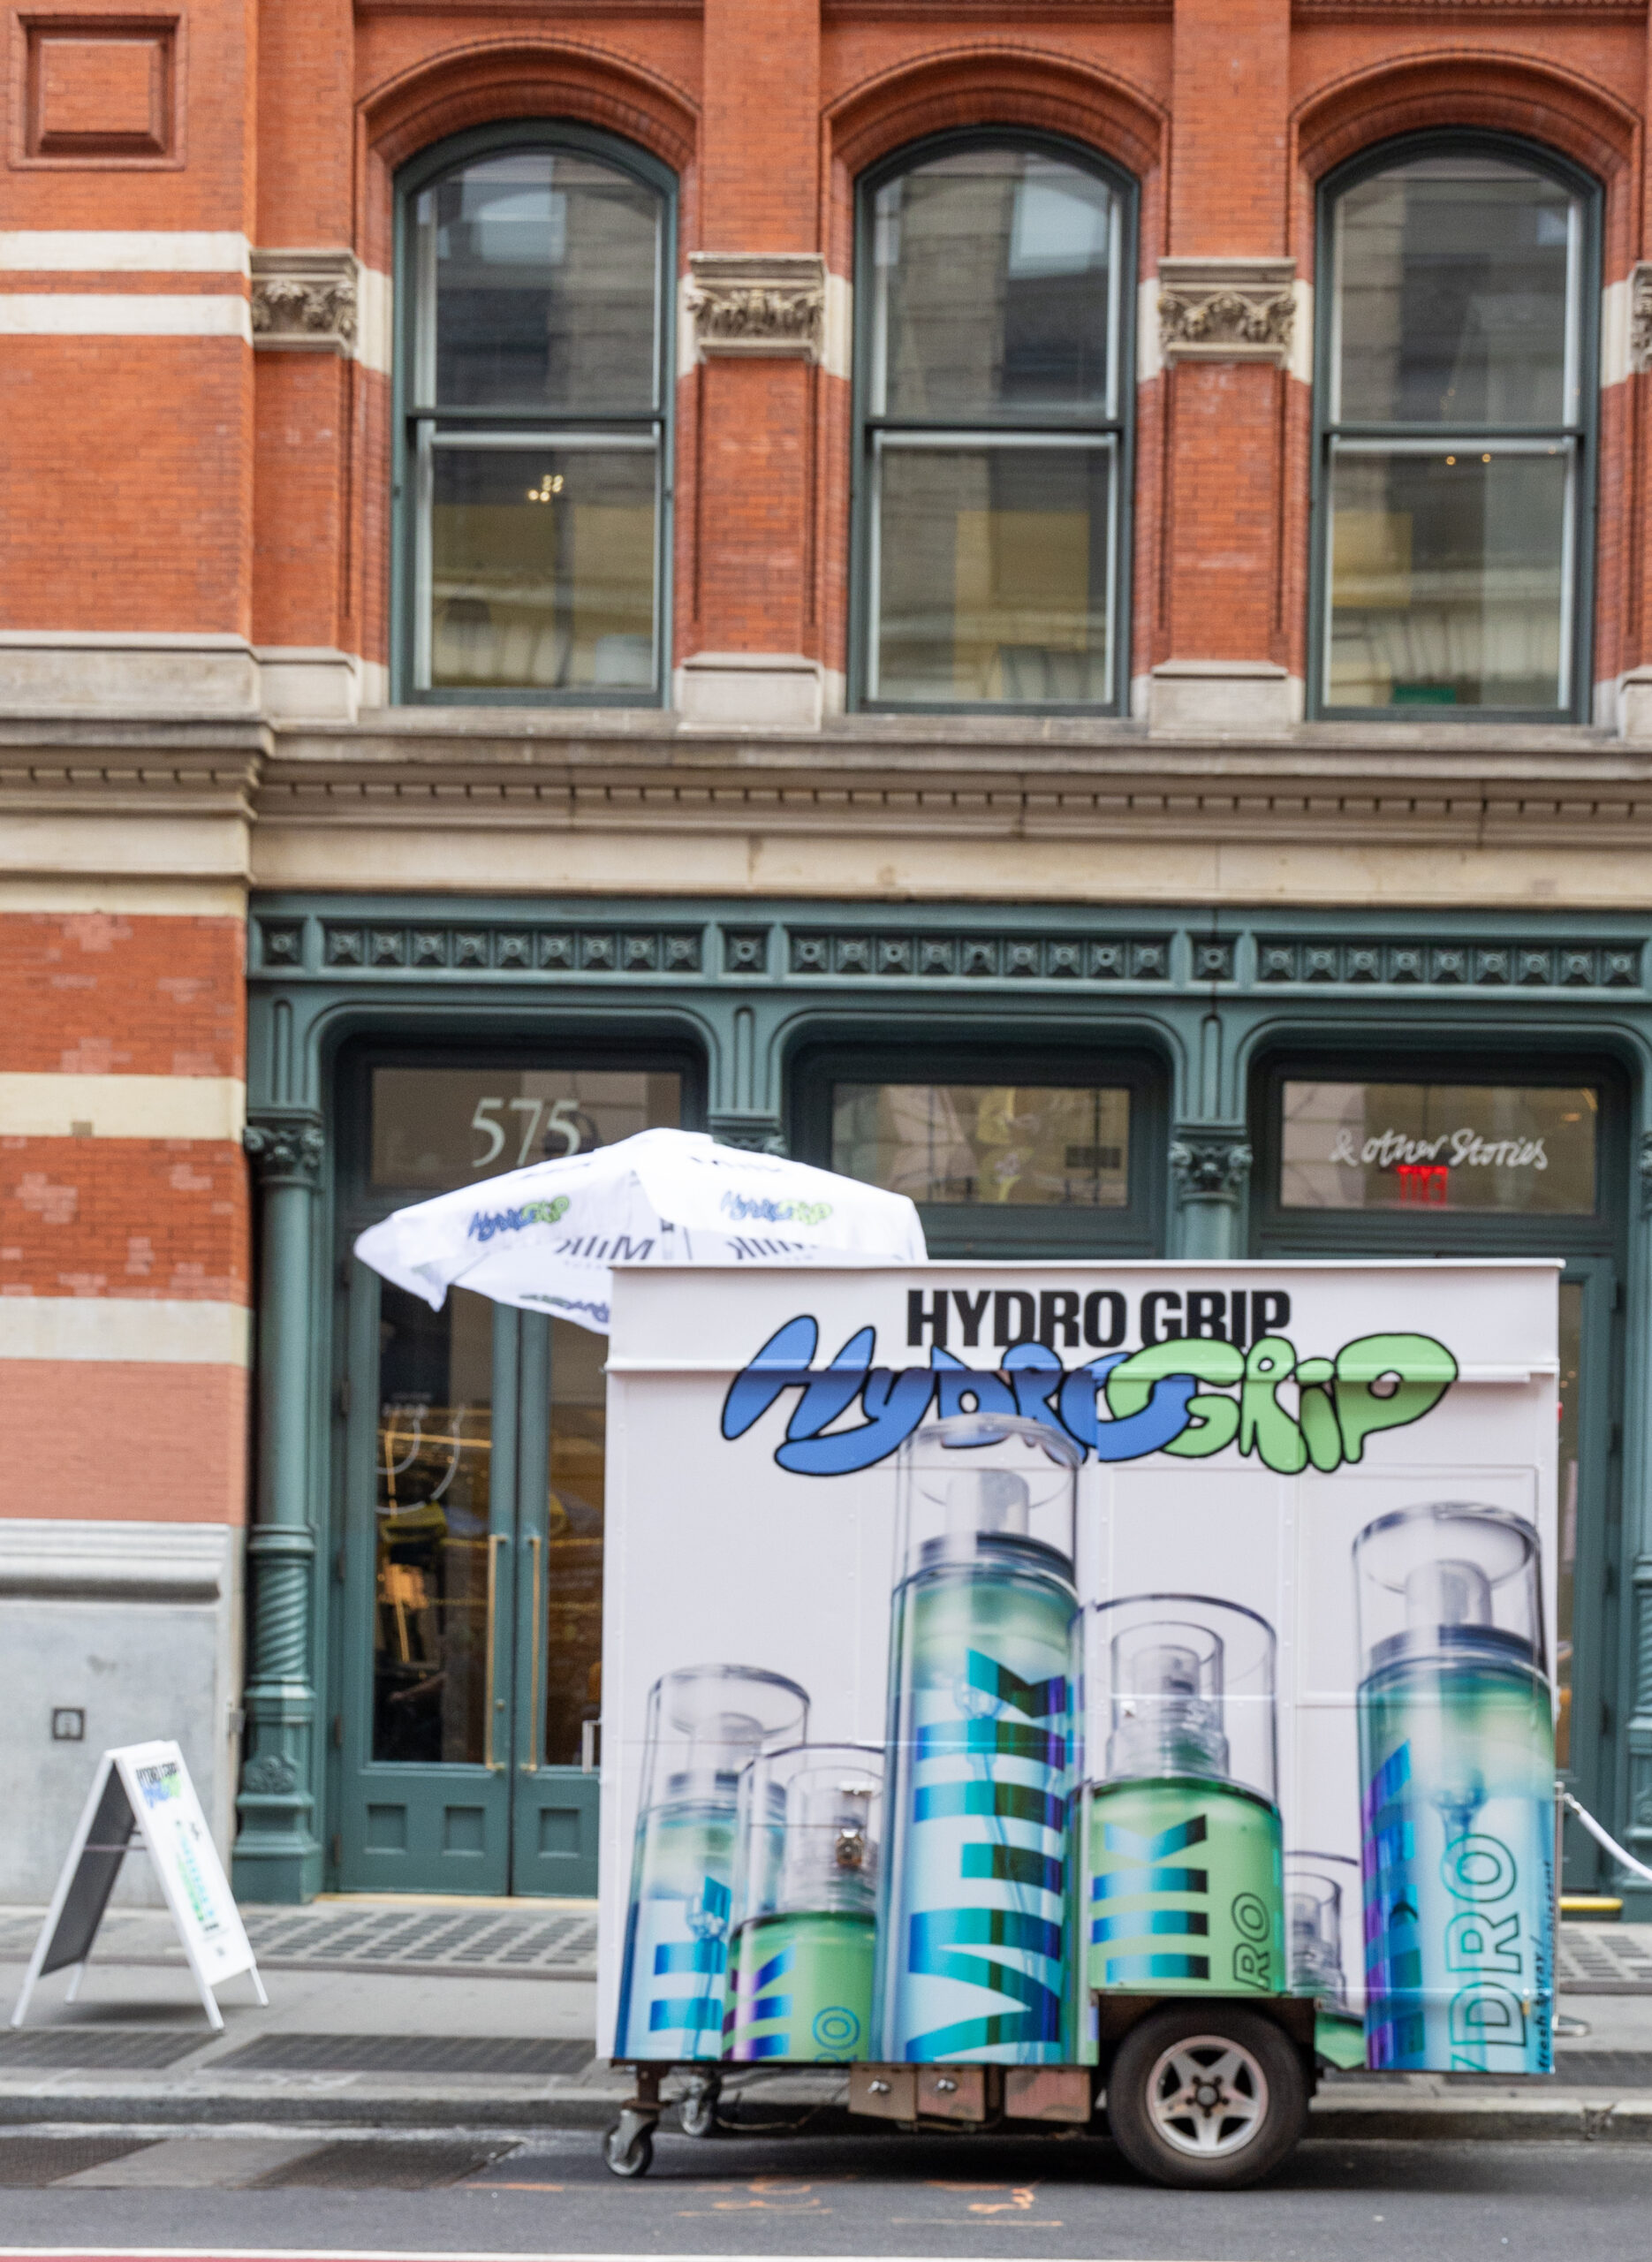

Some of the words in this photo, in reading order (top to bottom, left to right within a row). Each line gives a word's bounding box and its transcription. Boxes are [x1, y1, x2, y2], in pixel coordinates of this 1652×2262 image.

[471, 1097, 581, 1168] 575
[1330, 1127, 1359, 1167] &
[1361, 1128, 1451, 1167] other
[1450, 1127, 1549, 1171] Stories
[906, 1289, 1127, 1348] HYDRO
[1140, 1290, 1291, 1347] GRIP
